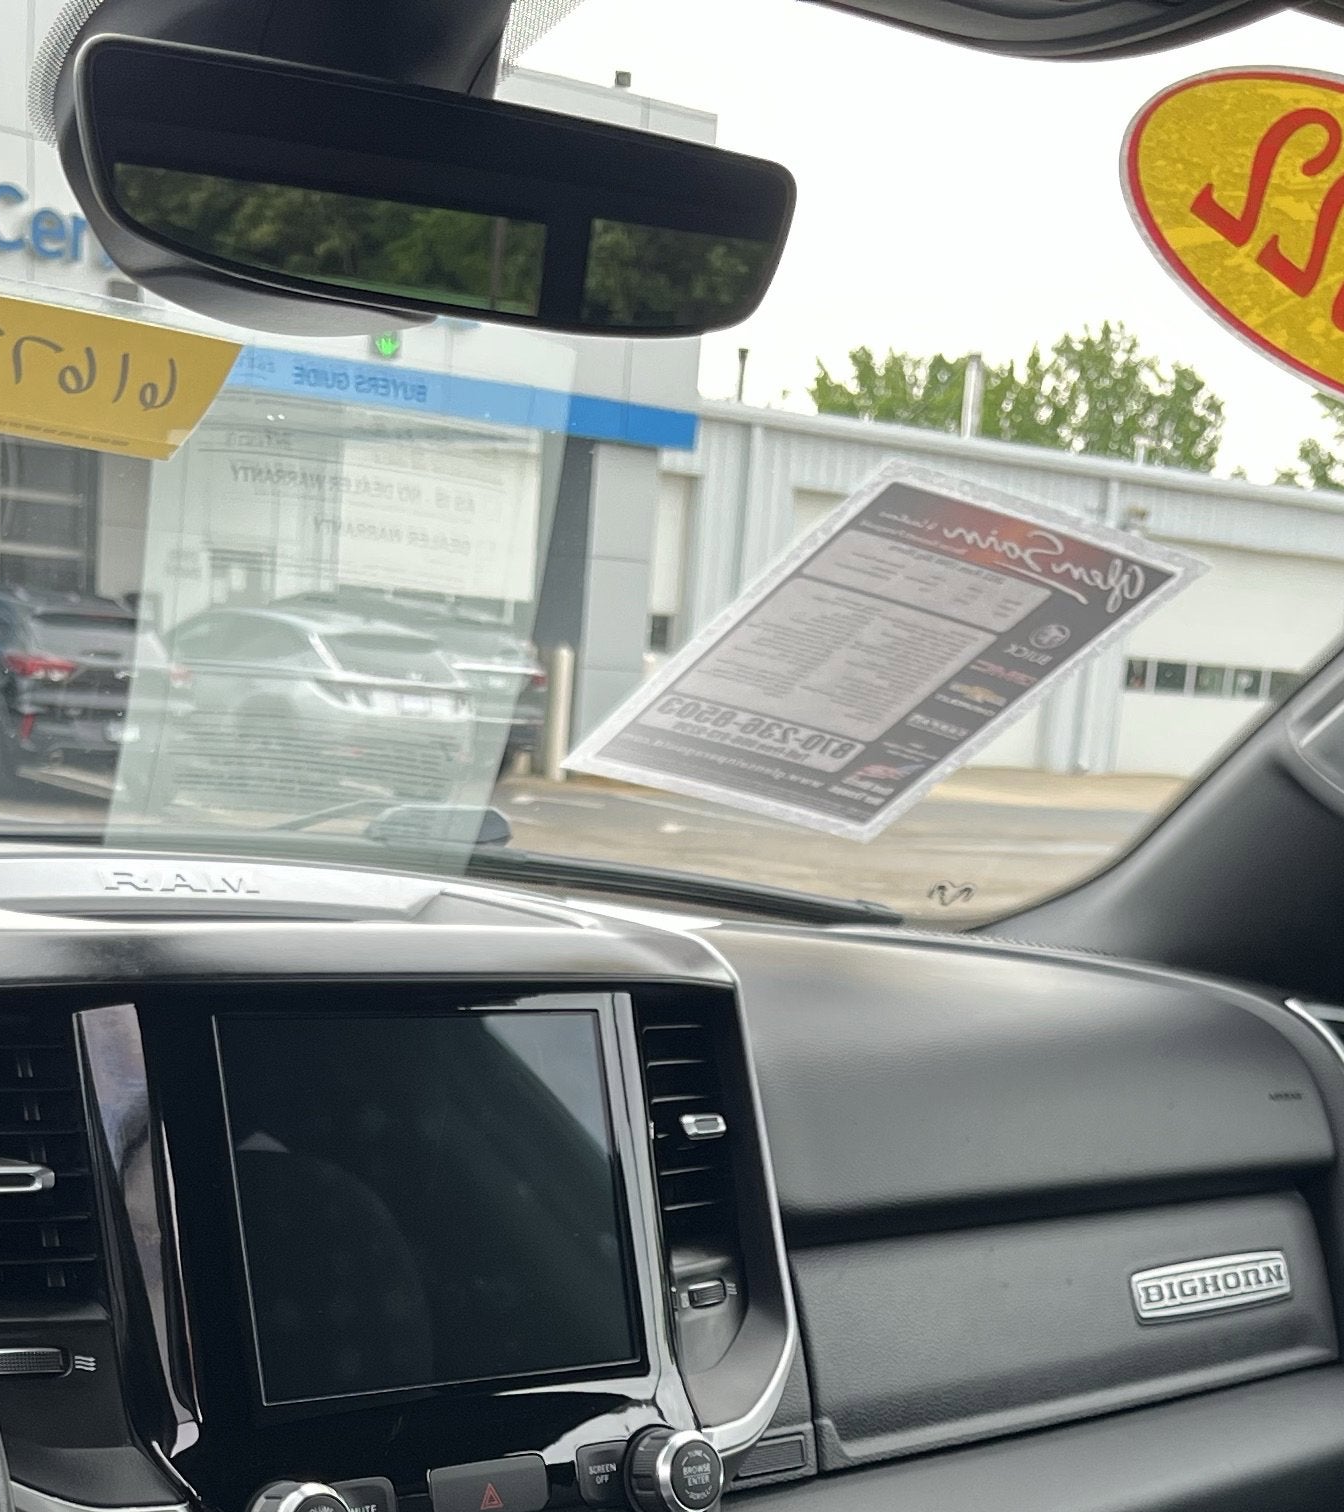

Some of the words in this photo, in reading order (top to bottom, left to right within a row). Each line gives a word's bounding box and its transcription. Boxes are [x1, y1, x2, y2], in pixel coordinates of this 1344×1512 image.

[105, 872, 260, 894] RAM
[1141, 1263, 1284, 1304] BIGHORN
[588, 1463, 617, 1475] SCREEN
[683, 1463, 711, 1476] BROWSE
[595, 1474, 610, 1485] OFF
[687, 1475, 710, 1487] ENTER
